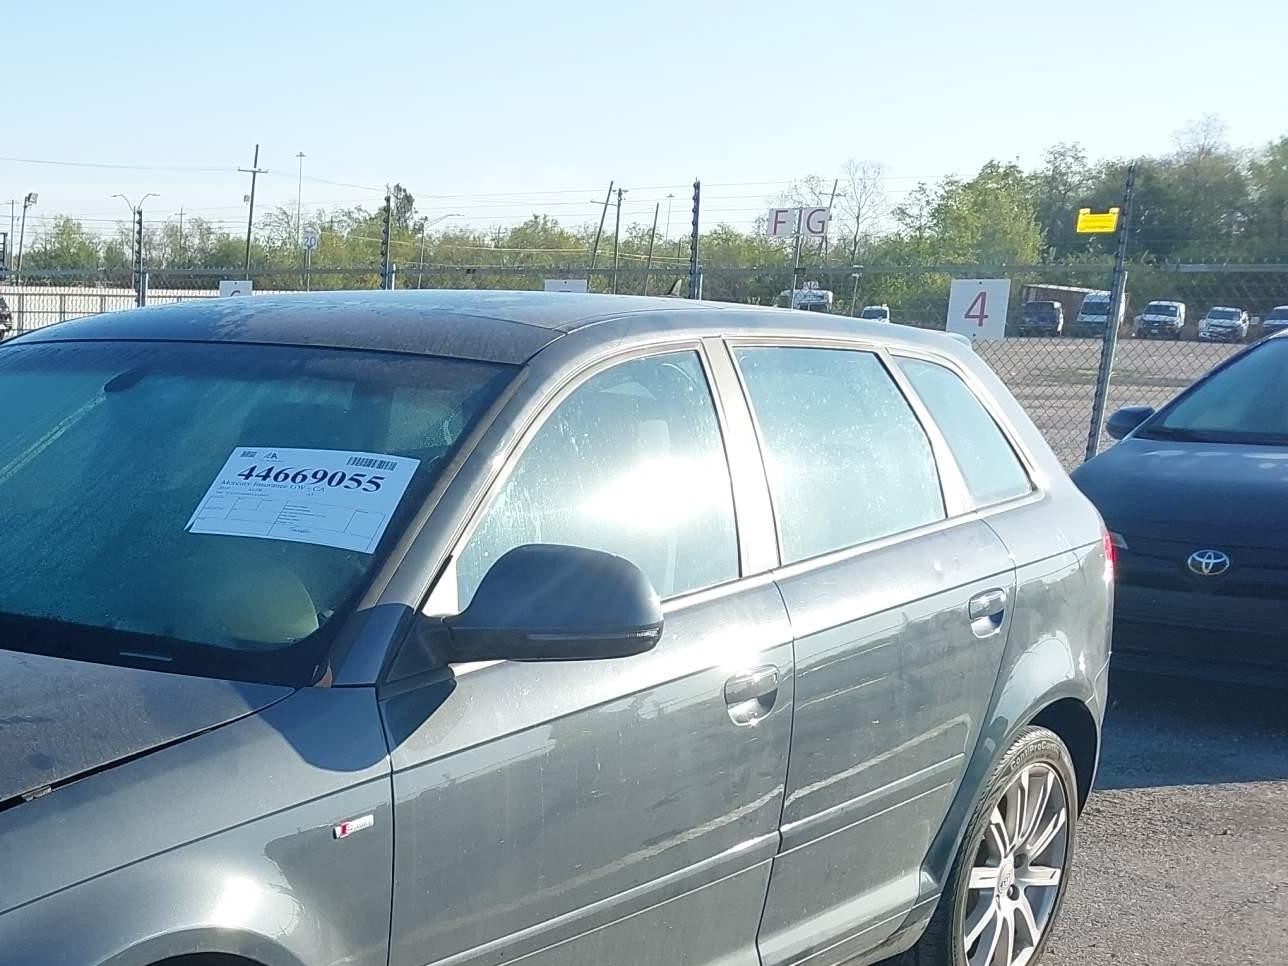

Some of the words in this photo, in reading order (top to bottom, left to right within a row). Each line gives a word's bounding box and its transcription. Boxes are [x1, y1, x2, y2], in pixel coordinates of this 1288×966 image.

[773, 209, 789, 235] F
[806, 208, 826, 235] G
[964, 291, 989, 327] 4
[238, 465, 385, 493] 44669055
